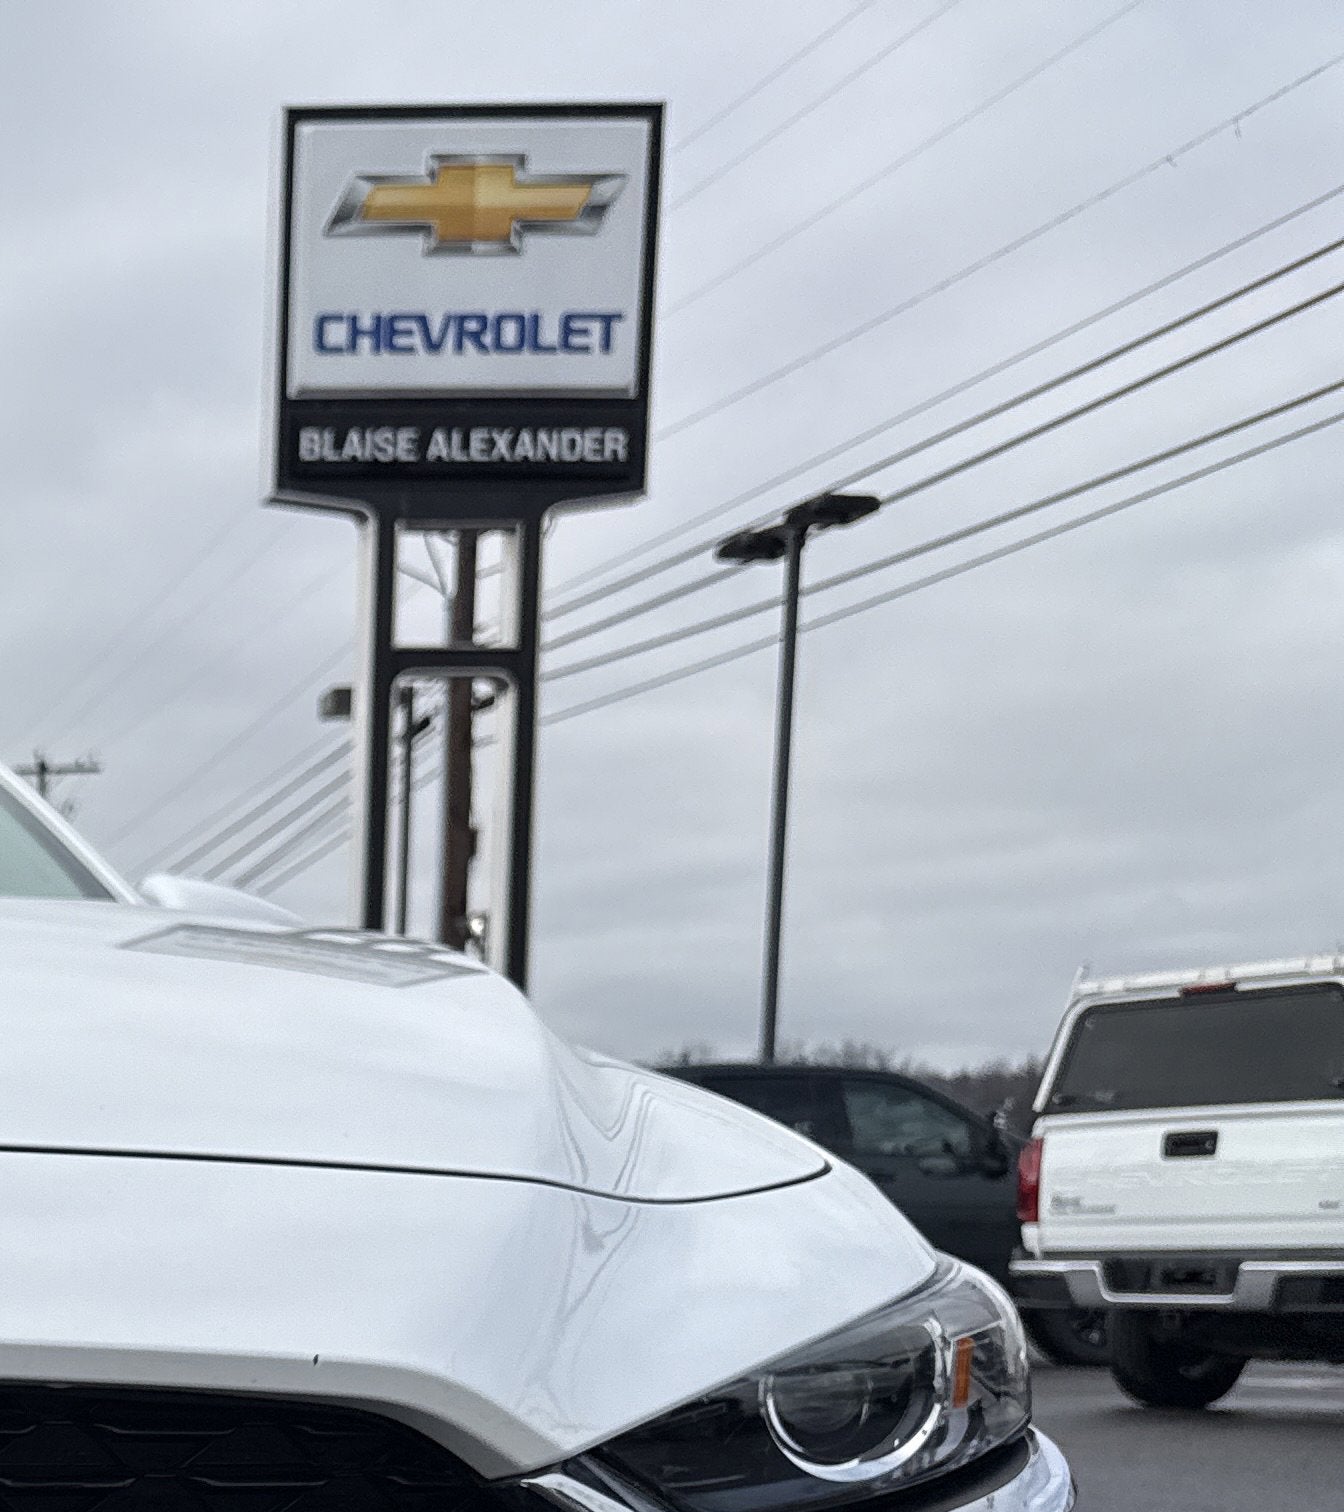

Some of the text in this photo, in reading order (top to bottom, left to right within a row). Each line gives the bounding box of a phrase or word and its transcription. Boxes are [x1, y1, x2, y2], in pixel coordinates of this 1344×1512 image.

[314, 312, 624, 356] CHEVROLET
[298, 426, 630, 464] BLAISE ALEXANDER
